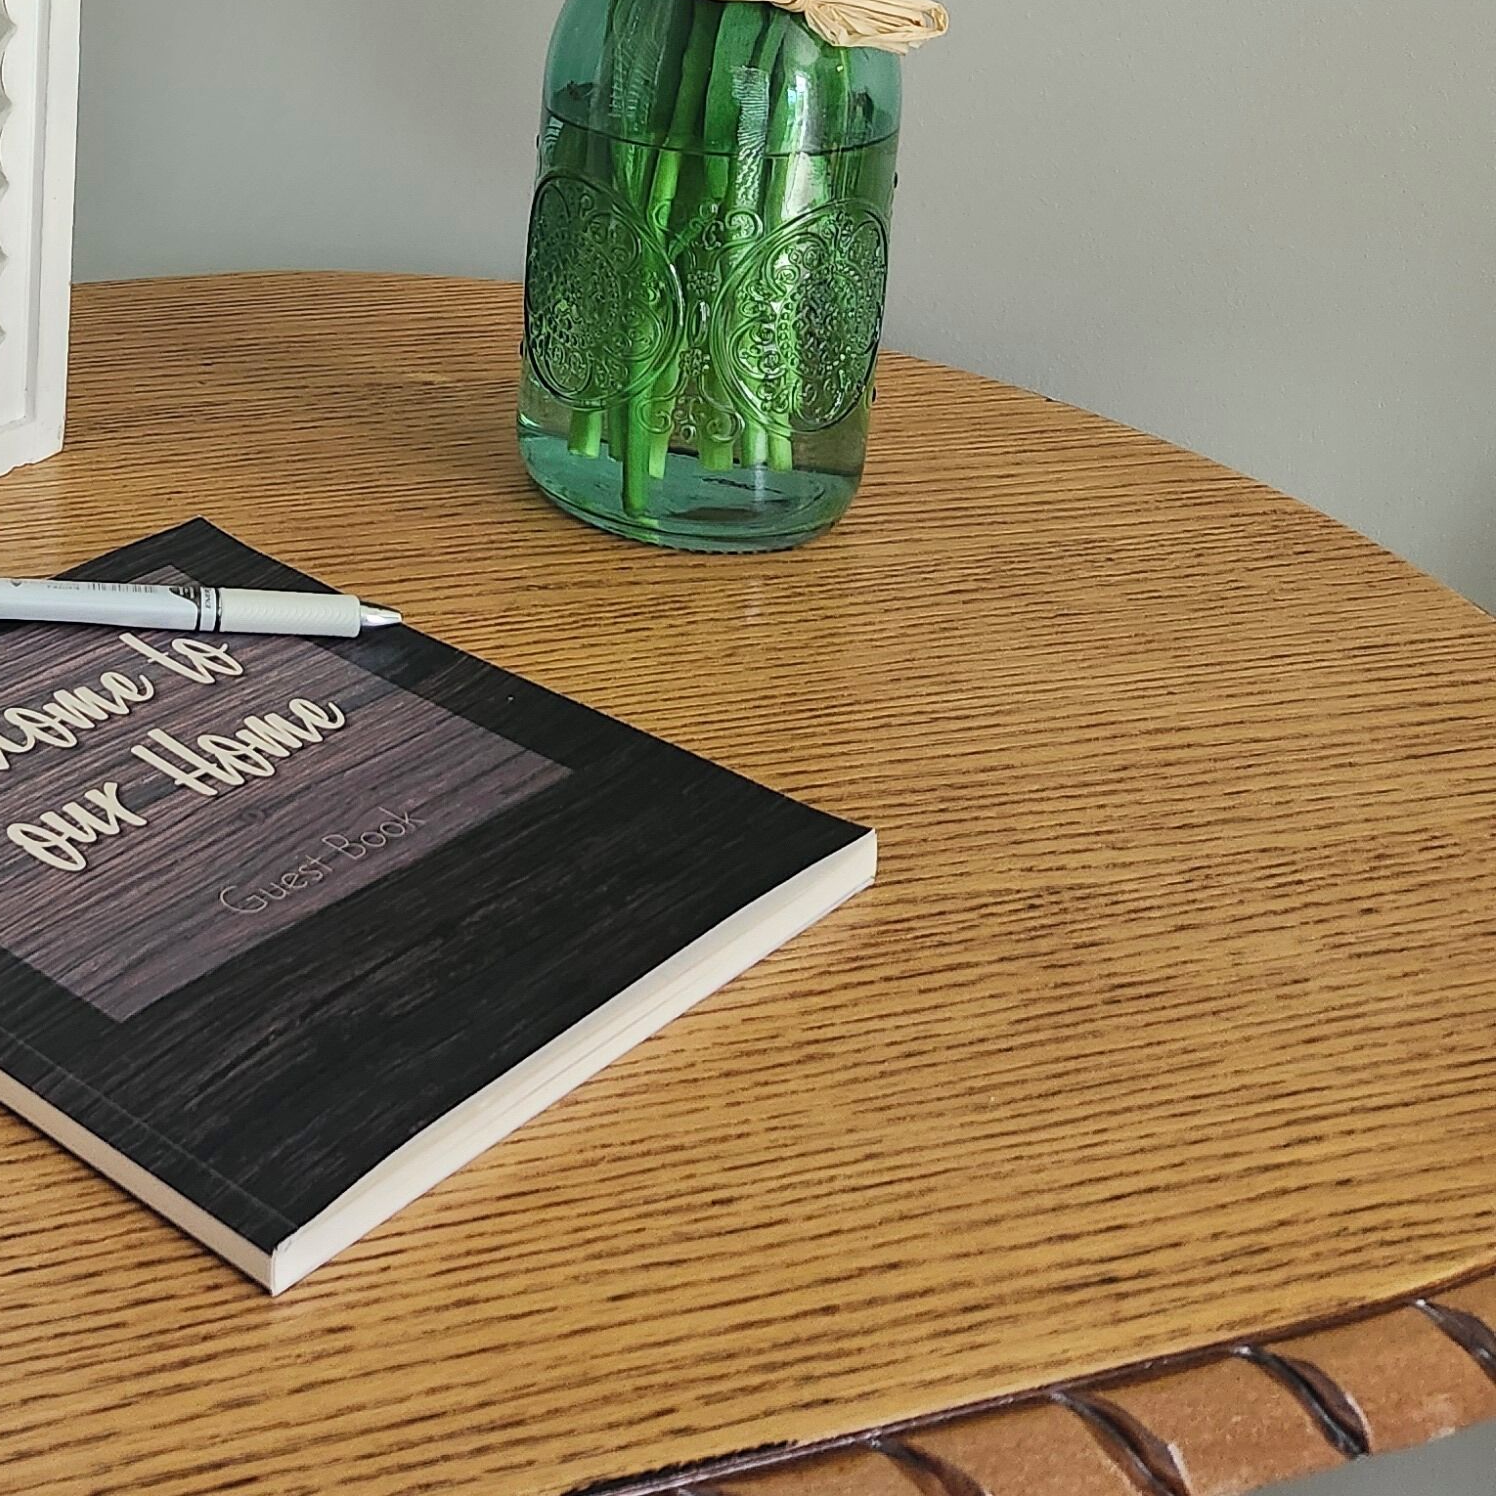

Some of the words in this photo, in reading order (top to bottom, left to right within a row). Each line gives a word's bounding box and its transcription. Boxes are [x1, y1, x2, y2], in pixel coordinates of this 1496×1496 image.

[118, 631, 244, 685] to
[6, 781, 148, 872] our
[130, 697, 347, 797] Home
[219, 854, 334, 914] Guest
[321, 806, 427, 860] Book
